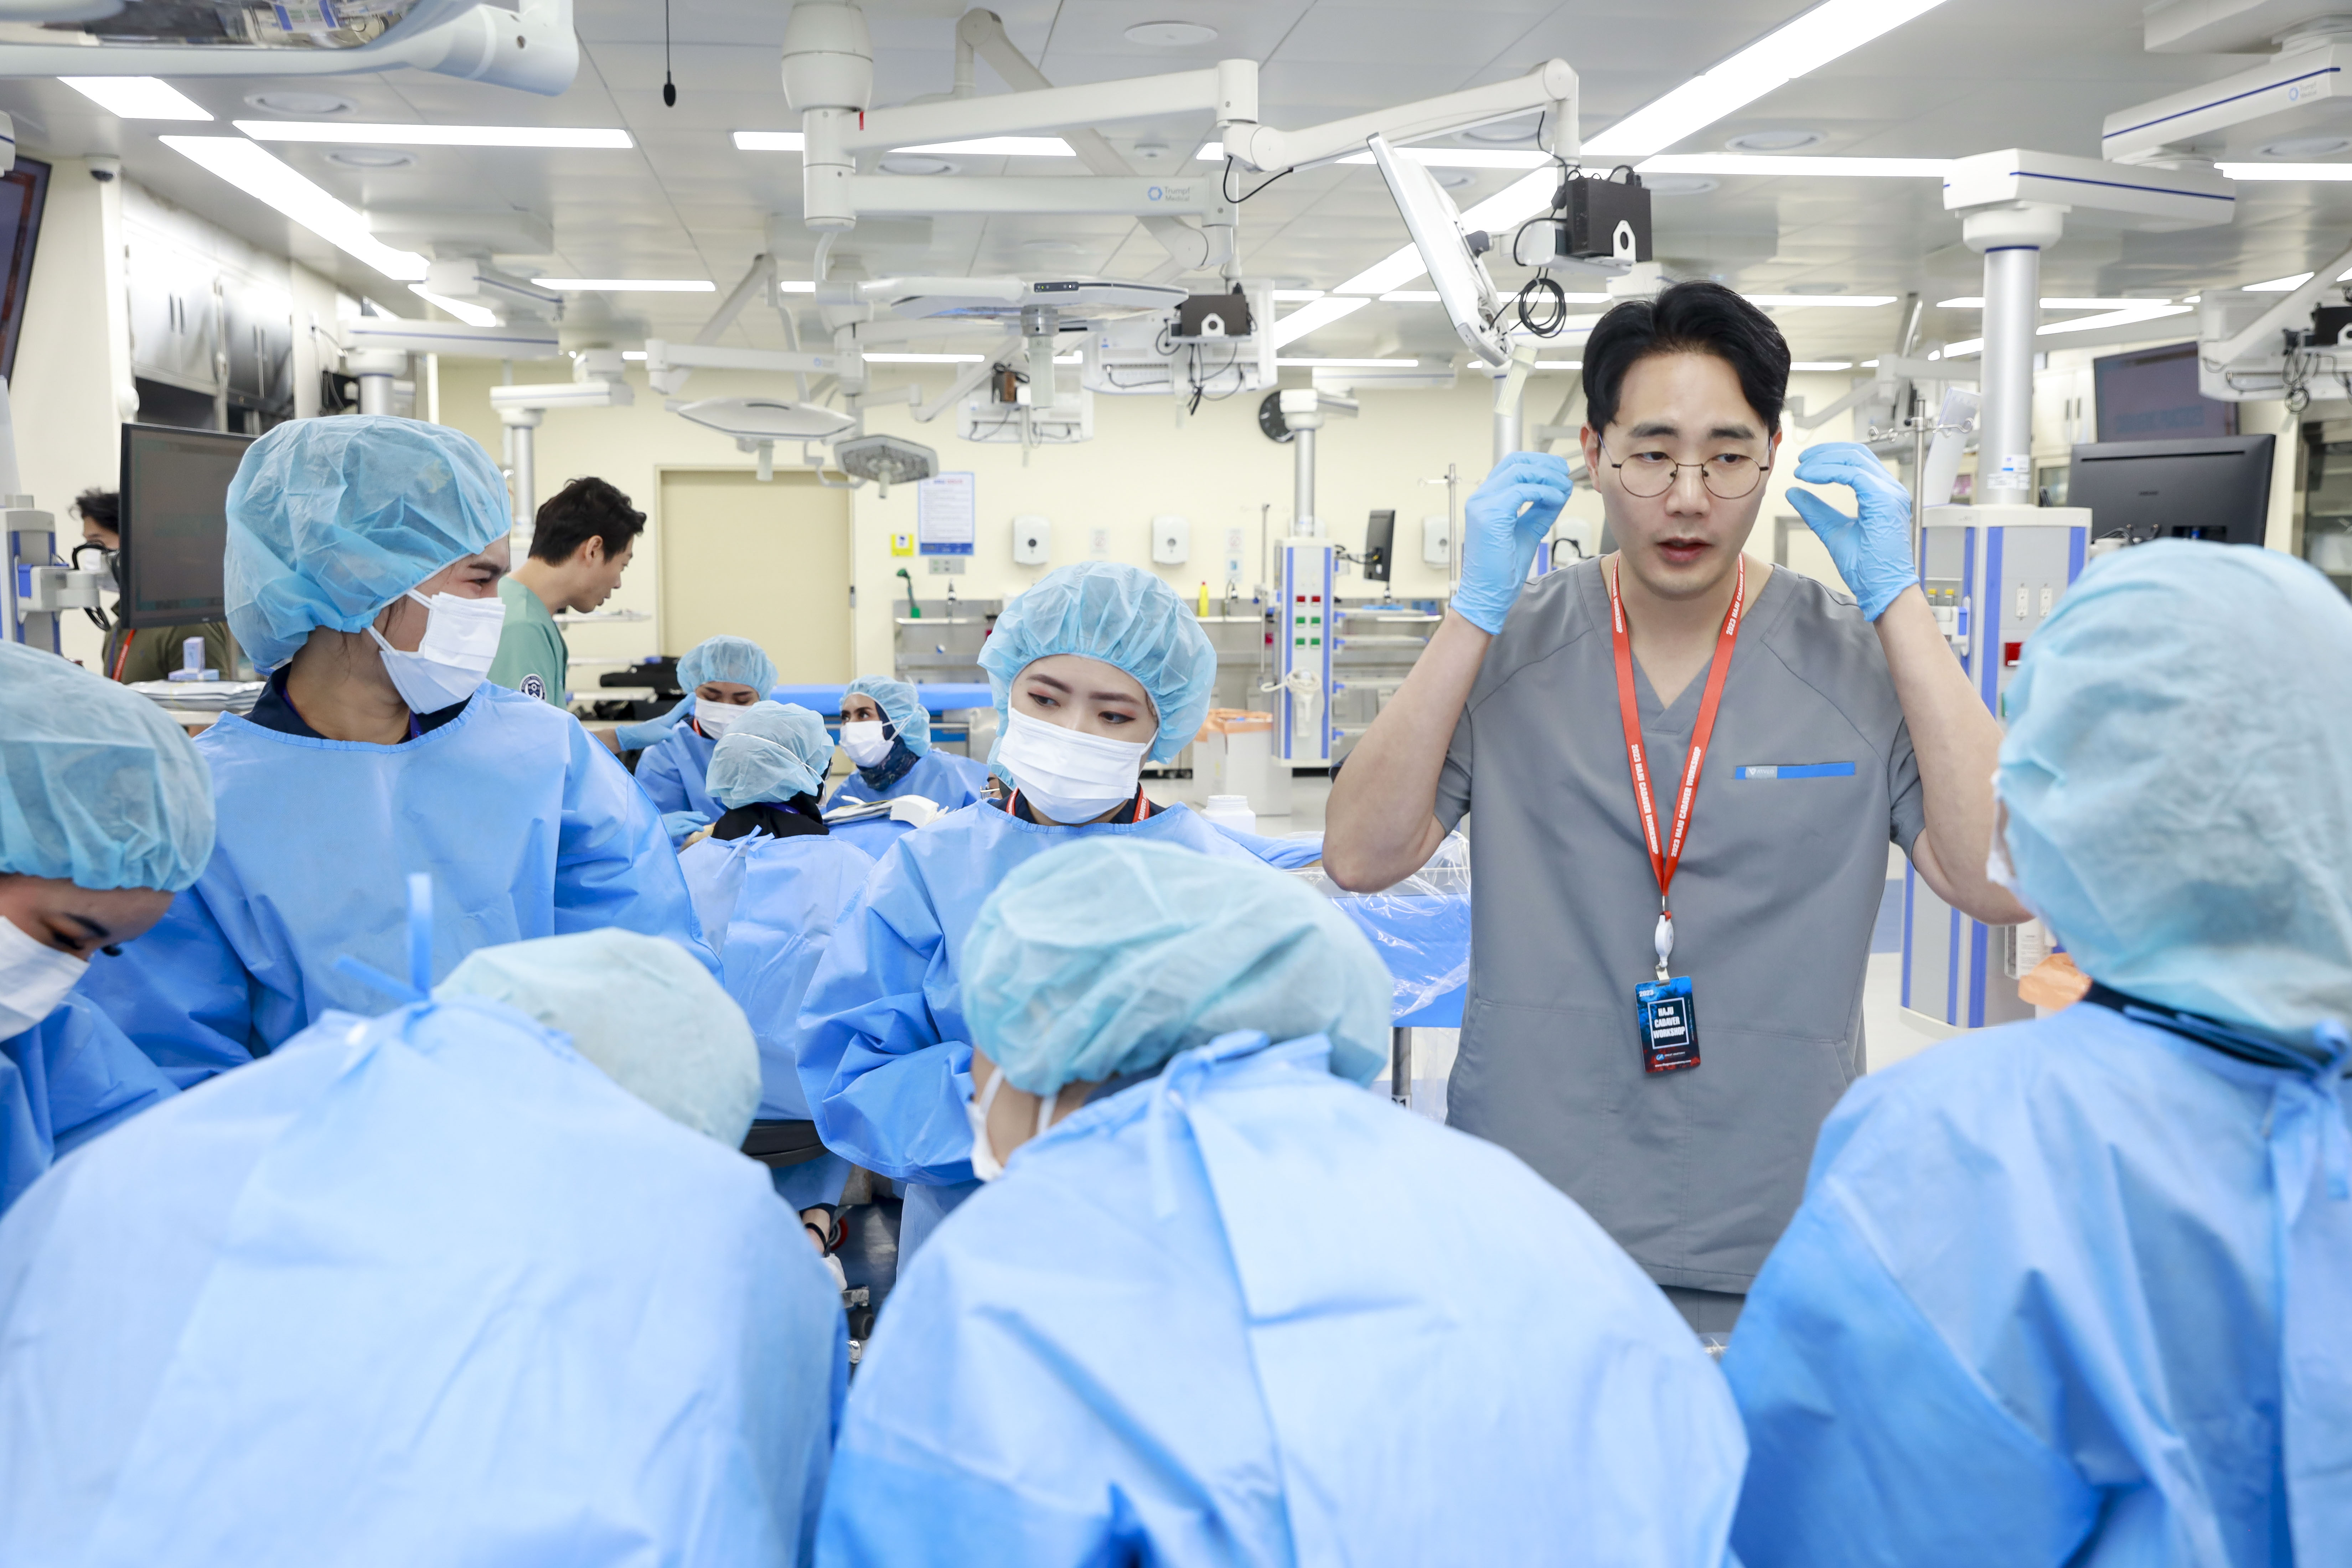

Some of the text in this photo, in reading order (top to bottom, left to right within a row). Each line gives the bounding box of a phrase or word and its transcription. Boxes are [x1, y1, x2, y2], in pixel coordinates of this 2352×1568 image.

[1613, 597, 1623, 633] WORKSHOP
[1726, 618, 1736, 636] 2023
[1732, 601, 1740, 618] HAJU
[1631, 744, 1659, 854] 2023 HAJU CADAVER WORKSHOP
[1671, 746, 1701, 857] 2023 HAJU CADAVER WORKSHOP
[1639, 989, 1654, 997] 2023
[1654, 1016, 1680, 1028] CADAVER
[1658, 1006, 1674, 1017] HAJU
[1653, 1026, 1685, 1039] WORKSHOP
